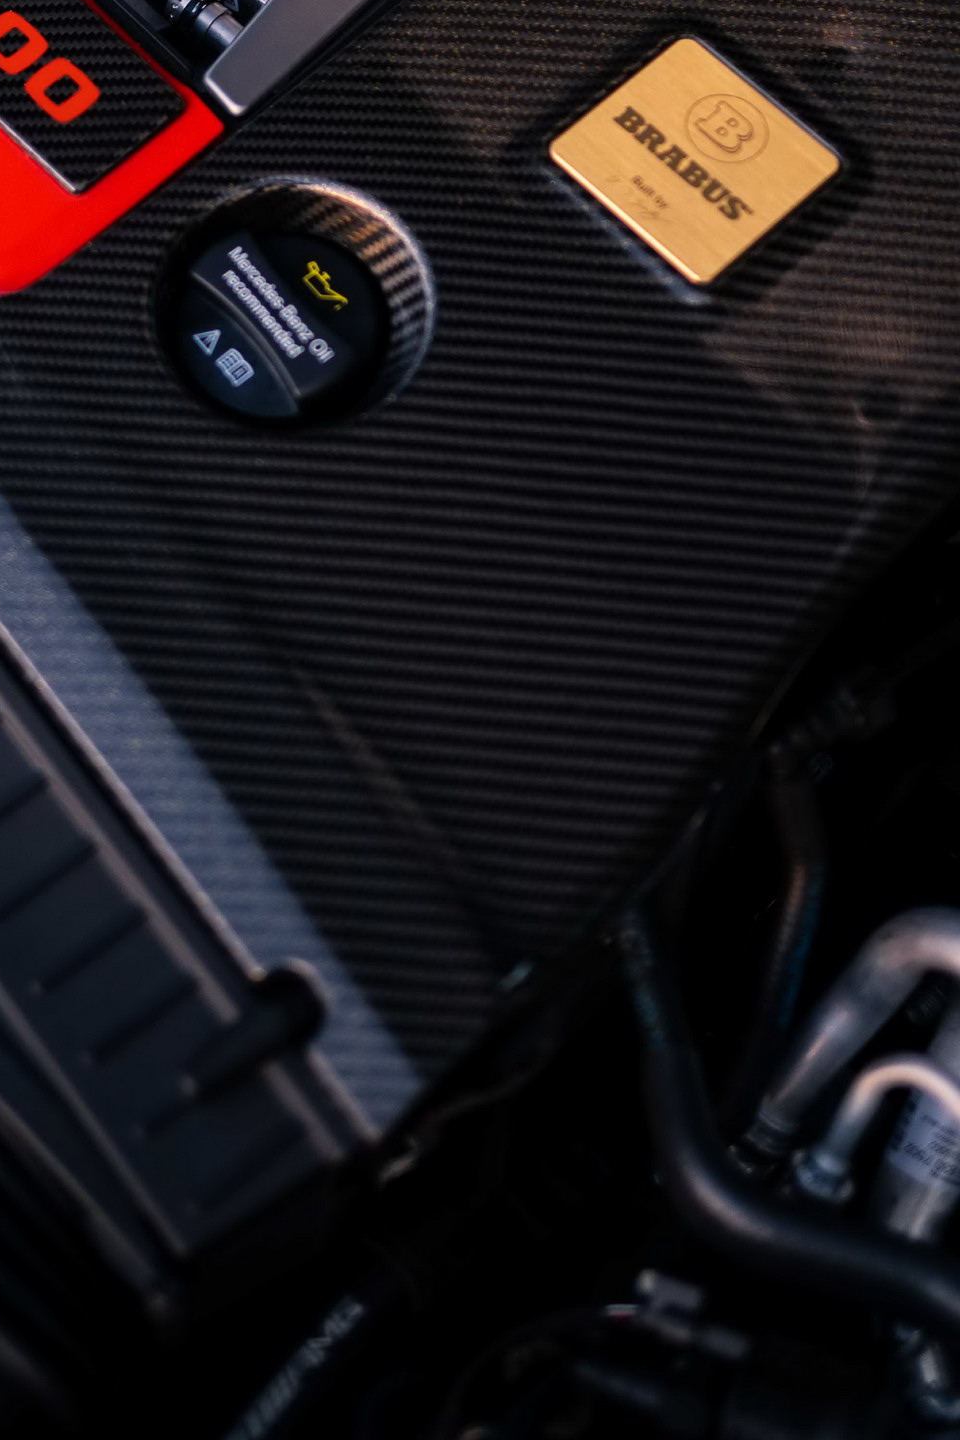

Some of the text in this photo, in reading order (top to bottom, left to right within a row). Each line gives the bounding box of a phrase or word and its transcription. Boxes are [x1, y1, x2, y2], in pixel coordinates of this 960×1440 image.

[613, 106, 754, 221] BRABUS
[693, 100, 755, 153] B
[221, 270, 305, 359] recommended
[227, 246, 336, 364] Mercedes-Benz Oil
